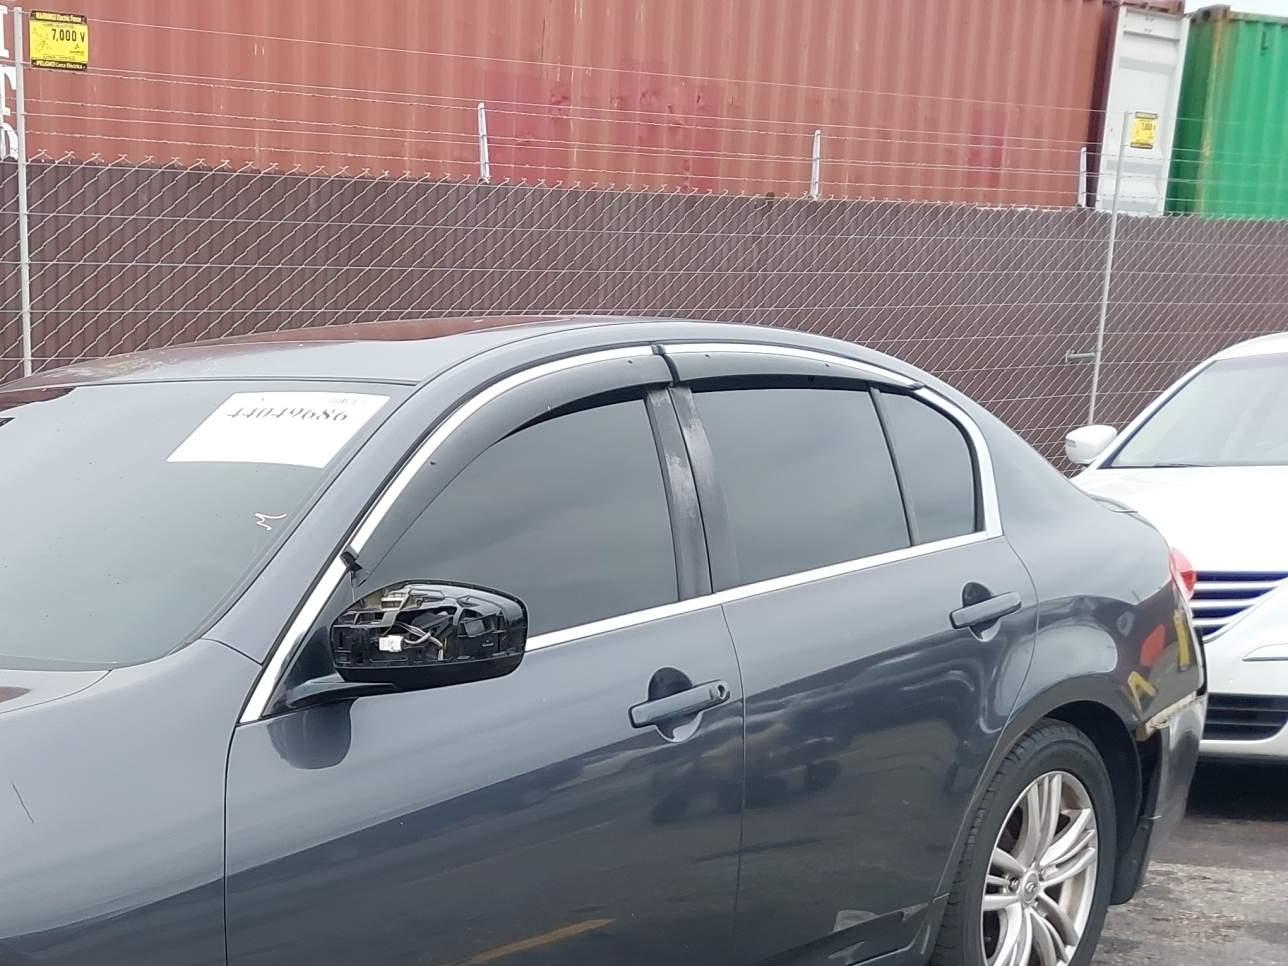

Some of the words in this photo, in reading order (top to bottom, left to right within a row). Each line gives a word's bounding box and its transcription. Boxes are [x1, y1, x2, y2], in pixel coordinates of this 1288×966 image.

[51, 28, 77, 42] 7,000
[79, 31, 86, 43] V
[226, 407, 349, 421] 44049686
